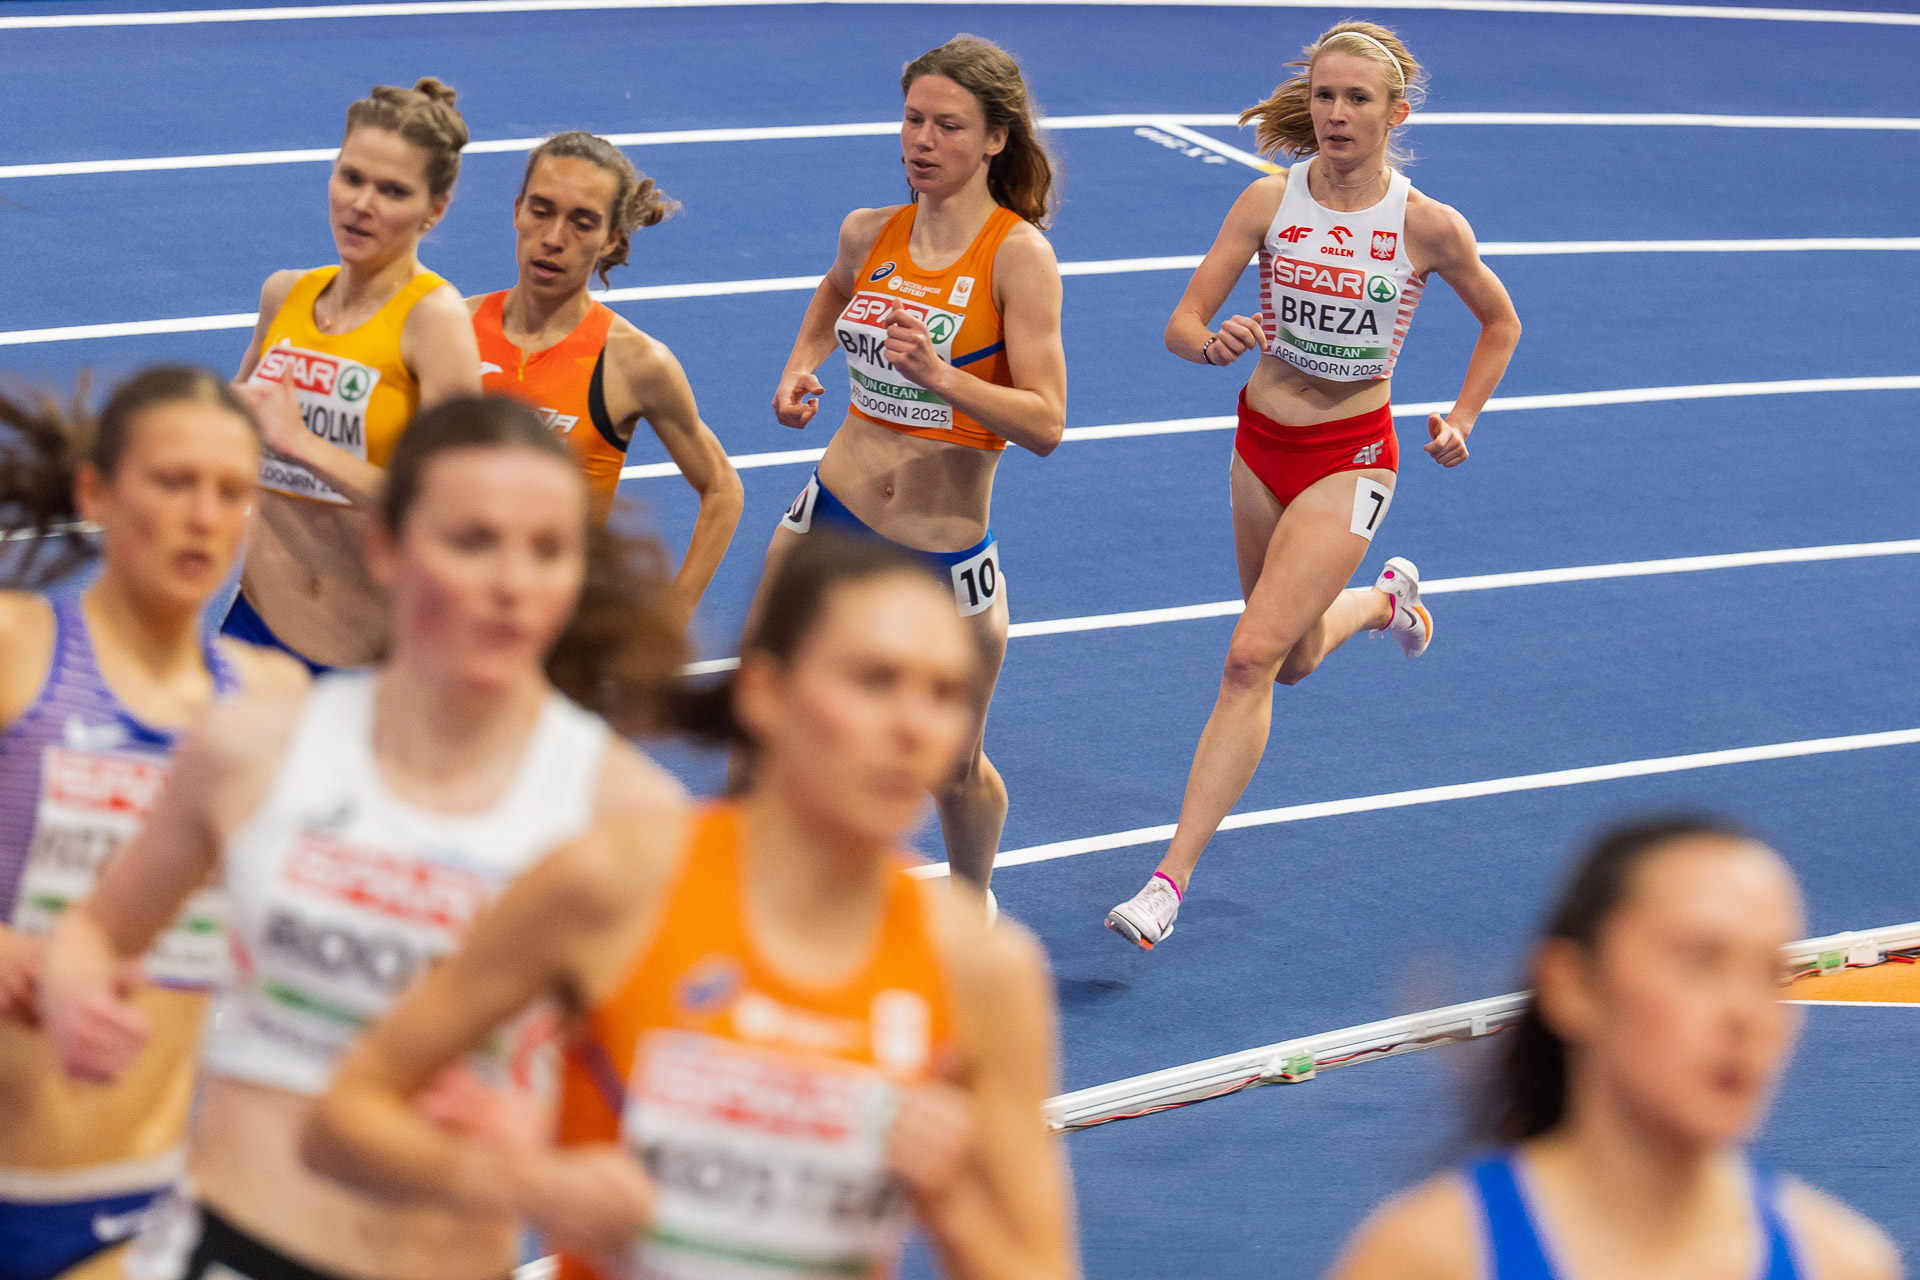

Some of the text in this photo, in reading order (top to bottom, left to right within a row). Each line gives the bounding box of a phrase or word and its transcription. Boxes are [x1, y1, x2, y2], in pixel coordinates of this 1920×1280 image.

[1278, 225, 1314, 243] 4F
[1320, 246, 1355, 258] ORLEN
[1275, 260, 1364, 296] SPAR
[1281, 295, 1379, 336] BREZA
[1275, 345, 1384, 376] APELDOORN 2025
[301, 402, 361, 445] HOLM
[911, 407, 948, 423] 2025
[1352, 440, 1384, 465] 4F
[1366, 490, 1385, 531] 7
[960, 557, 996, 607] 10
